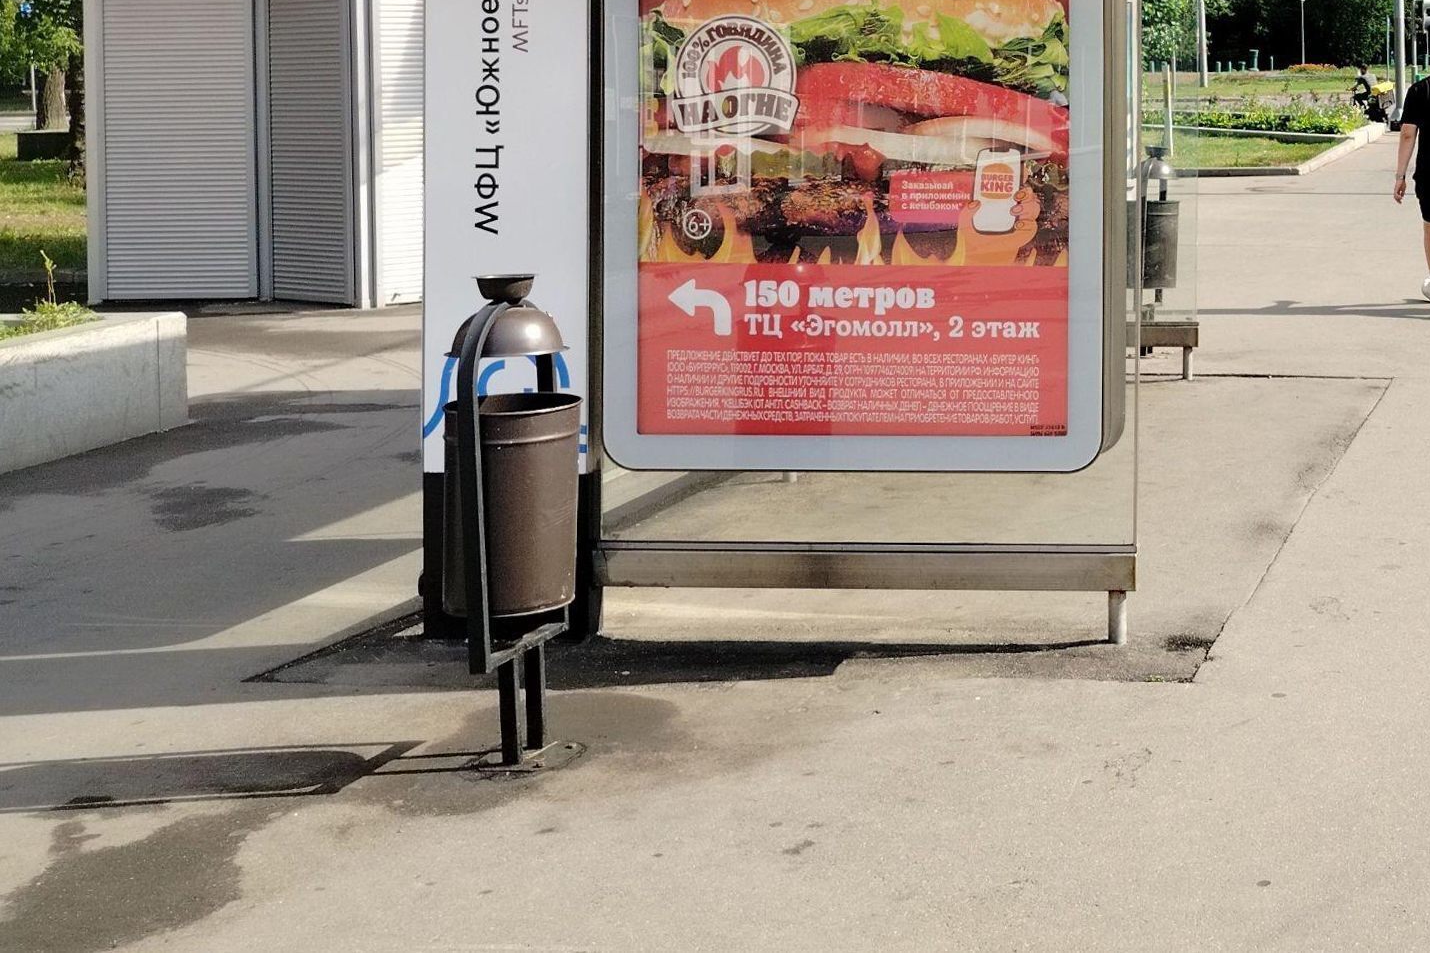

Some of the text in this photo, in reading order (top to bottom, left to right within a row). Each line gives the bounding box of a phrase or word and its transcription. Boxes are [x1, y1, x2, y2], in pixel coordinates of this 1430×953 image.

[682, 22, 787, 80] 100% ГОВЯДИНА
[678, 93, 792, 126] НА ОГНЕ
[981, 173, 1014, 182] BURGER
[474, 145, 504, 235] МФЦ
[902, 180, 953, 190] Заказывай
[980, 181, 1014, 193] KING
[910, 193, 971, 202] приложении
[688, 216, 710, 232] 6+
[744, 279, 936, 315] 150 метров
[744, 313, 1041, 341] ТЦ «Эгомолл», 2 этаж
[668, 350, 721, 361] ПРЕДЛОЖЕНИЕ
[722, 351, 760, 362] ДЕЙСТВУЕТ
[761, 351, 772, 362] ДО
[774, 351, 785, 361] ТЕХ
[804, 352, 825, 362] ПОКА
[826, 352, 848, 362] ТОВАР
[850, 352, 866, 362] ЕСТЬ
[912, 353, 923, 363] ВО
[924, 354, 942, 363] ВСЕХ
[943, 354, 988, 363] РЕСТОРАНАХ
[984, 367, 1040, 377] ИНФОРМАЦИЮ
[744, 375, 798, 386] ПОДРОБНОСТИ
[845, 376, 896, 387] СОТРУДНИКОВ
[1017, 378, 1039, 387] САЙТЕ
[769, 387, 807, 397] ВНЕШНИЙ
[810, 387, 825, 398] ВИД
[829, 388, 867, 399] ПРОДУКТА
[870, 388, 898, 398] МОЖЕТ
[901, 389, 946, 399] ОТЛИЧАТЬСЯ
[950, 390, 959, 399] ОТ
[963, 390, 1040, 401] ПРЕДОСТАВЛЕННОГО
